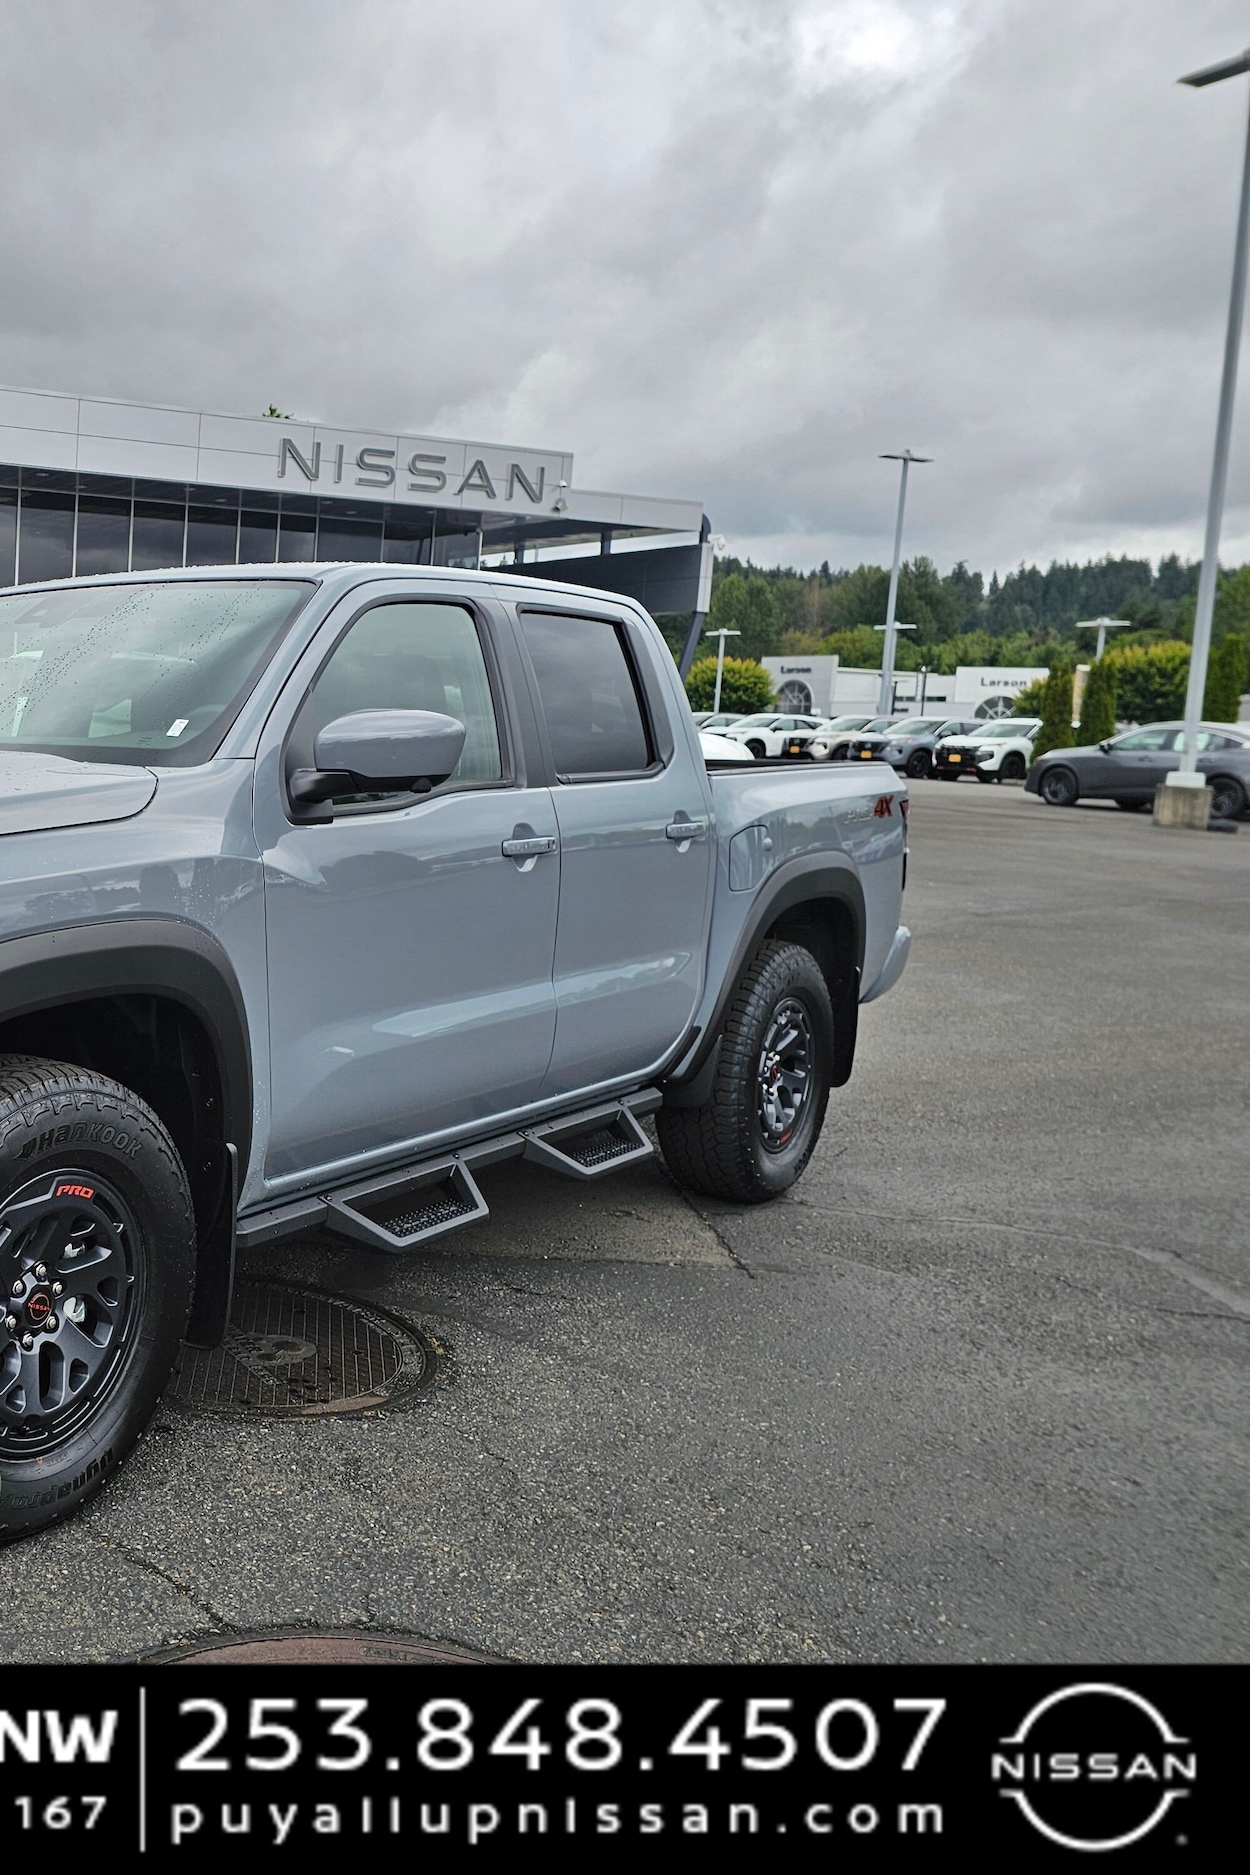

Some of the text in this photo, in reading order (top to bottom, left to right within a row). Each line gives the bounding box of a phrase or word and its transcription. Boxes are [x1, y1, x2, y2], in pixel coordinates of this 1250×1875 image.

[278, 438, 545, 503] NISSAN
[780, 665, 812, 674] Larson
[980, 677, 1027, 687] Larson
[56, 1185, 94, 1199] PRO
